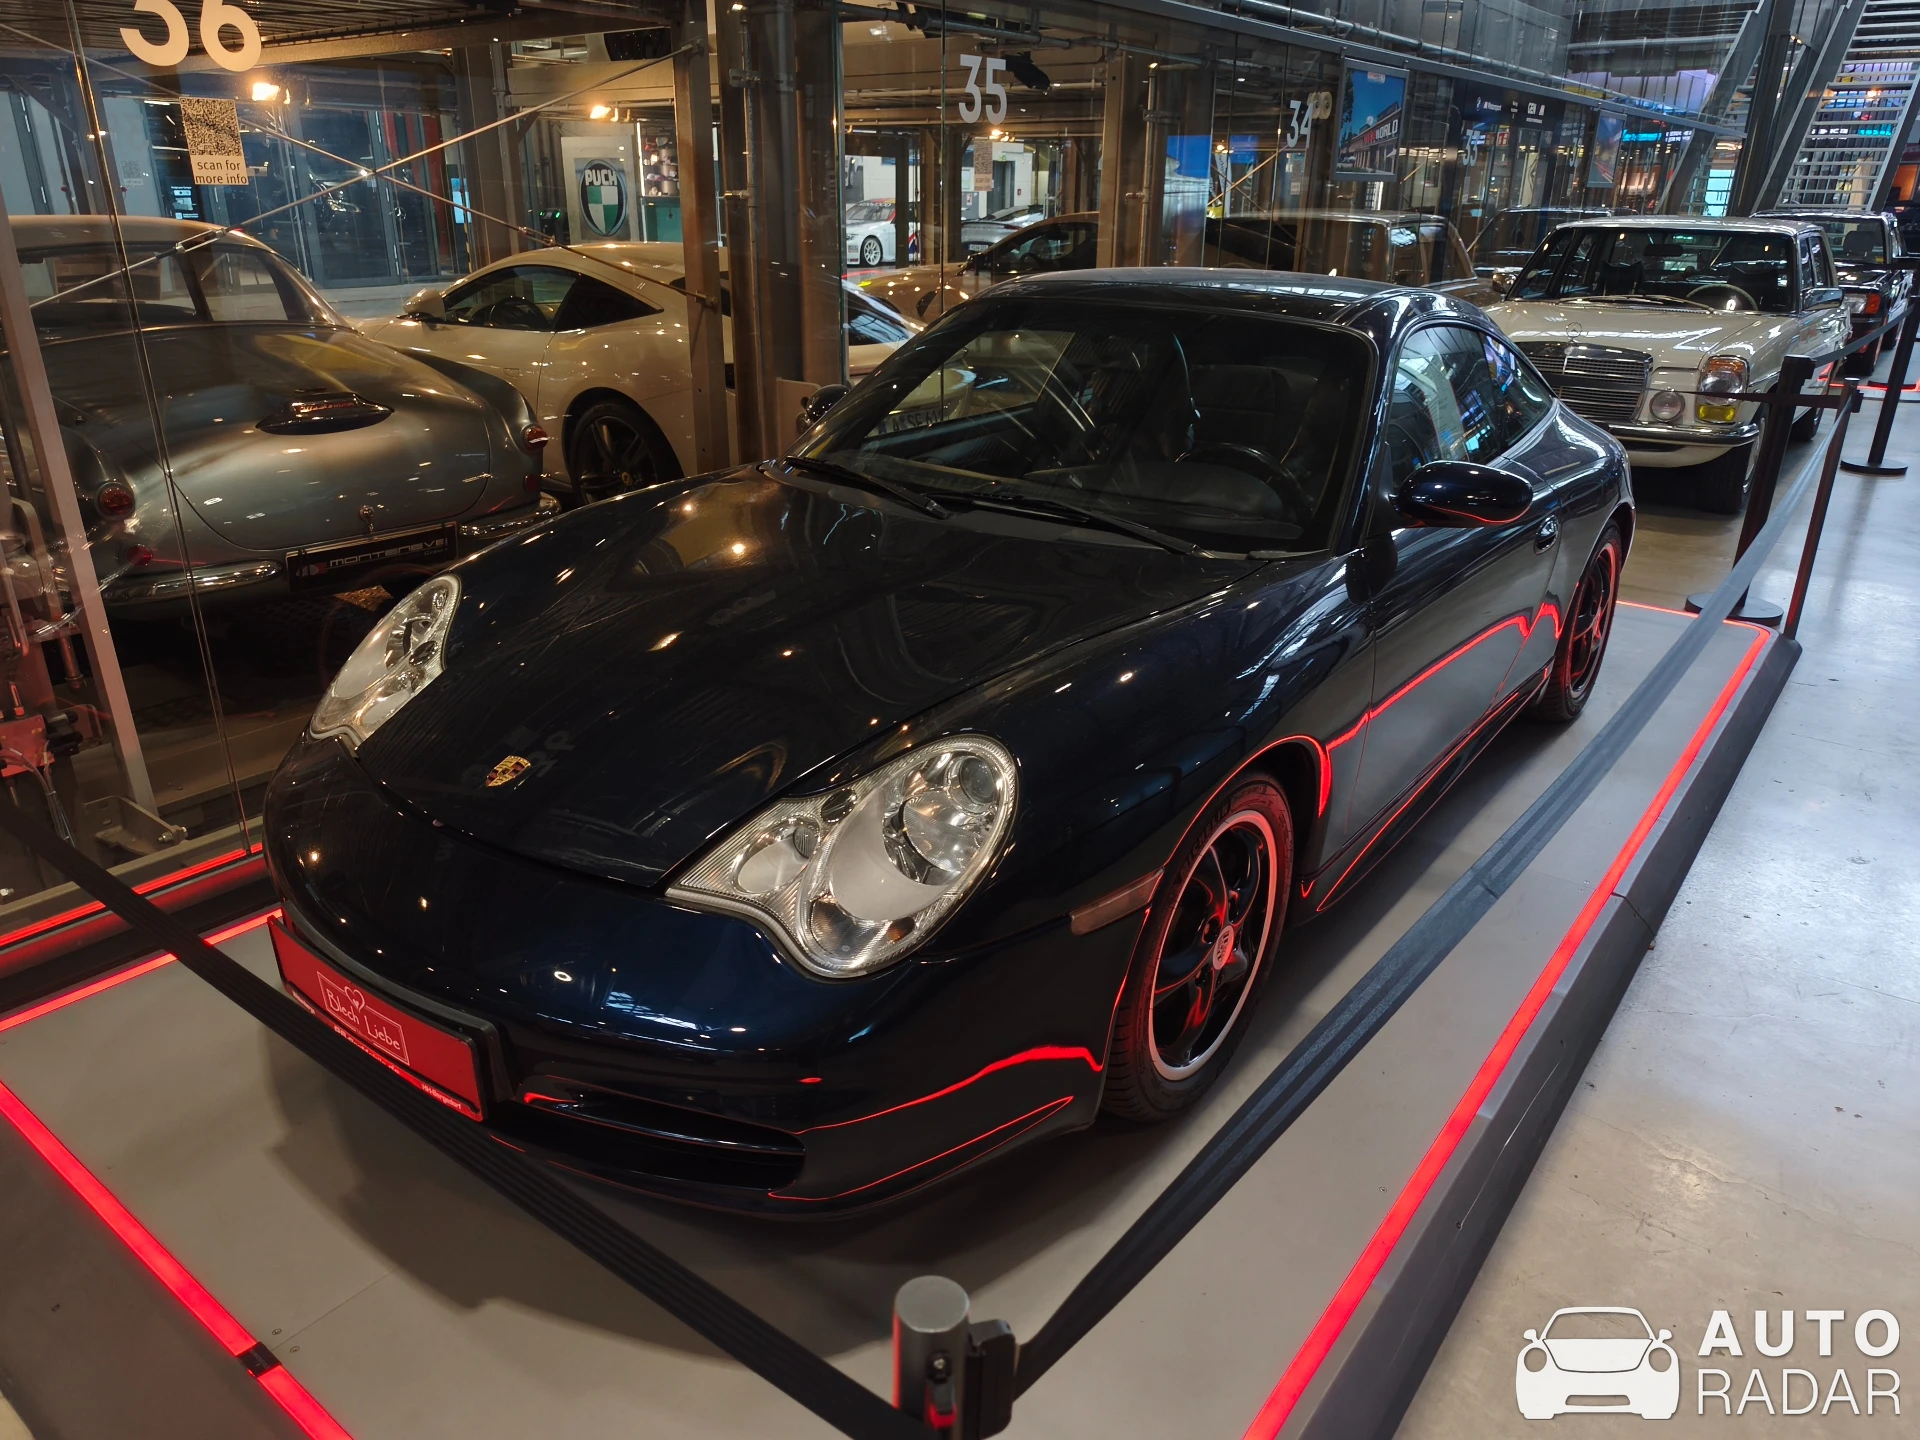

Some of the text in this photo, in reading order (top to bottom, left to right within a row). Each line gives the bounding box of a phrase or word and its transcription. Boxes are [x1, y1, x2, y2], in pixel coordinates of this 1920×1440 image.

[959, 54, 1008, 125] 35
[1286, 100, 1314, 149] 34
[196, 159, 241, 171] scan for
[1462, 129, 1480, 166] 33
[195, 173, 247, 184] more info
[585, 169, 618, 186] PUCH
[326, 988, 360, 1025] Blech
[363, 1015, 401, 1050] Liebe
